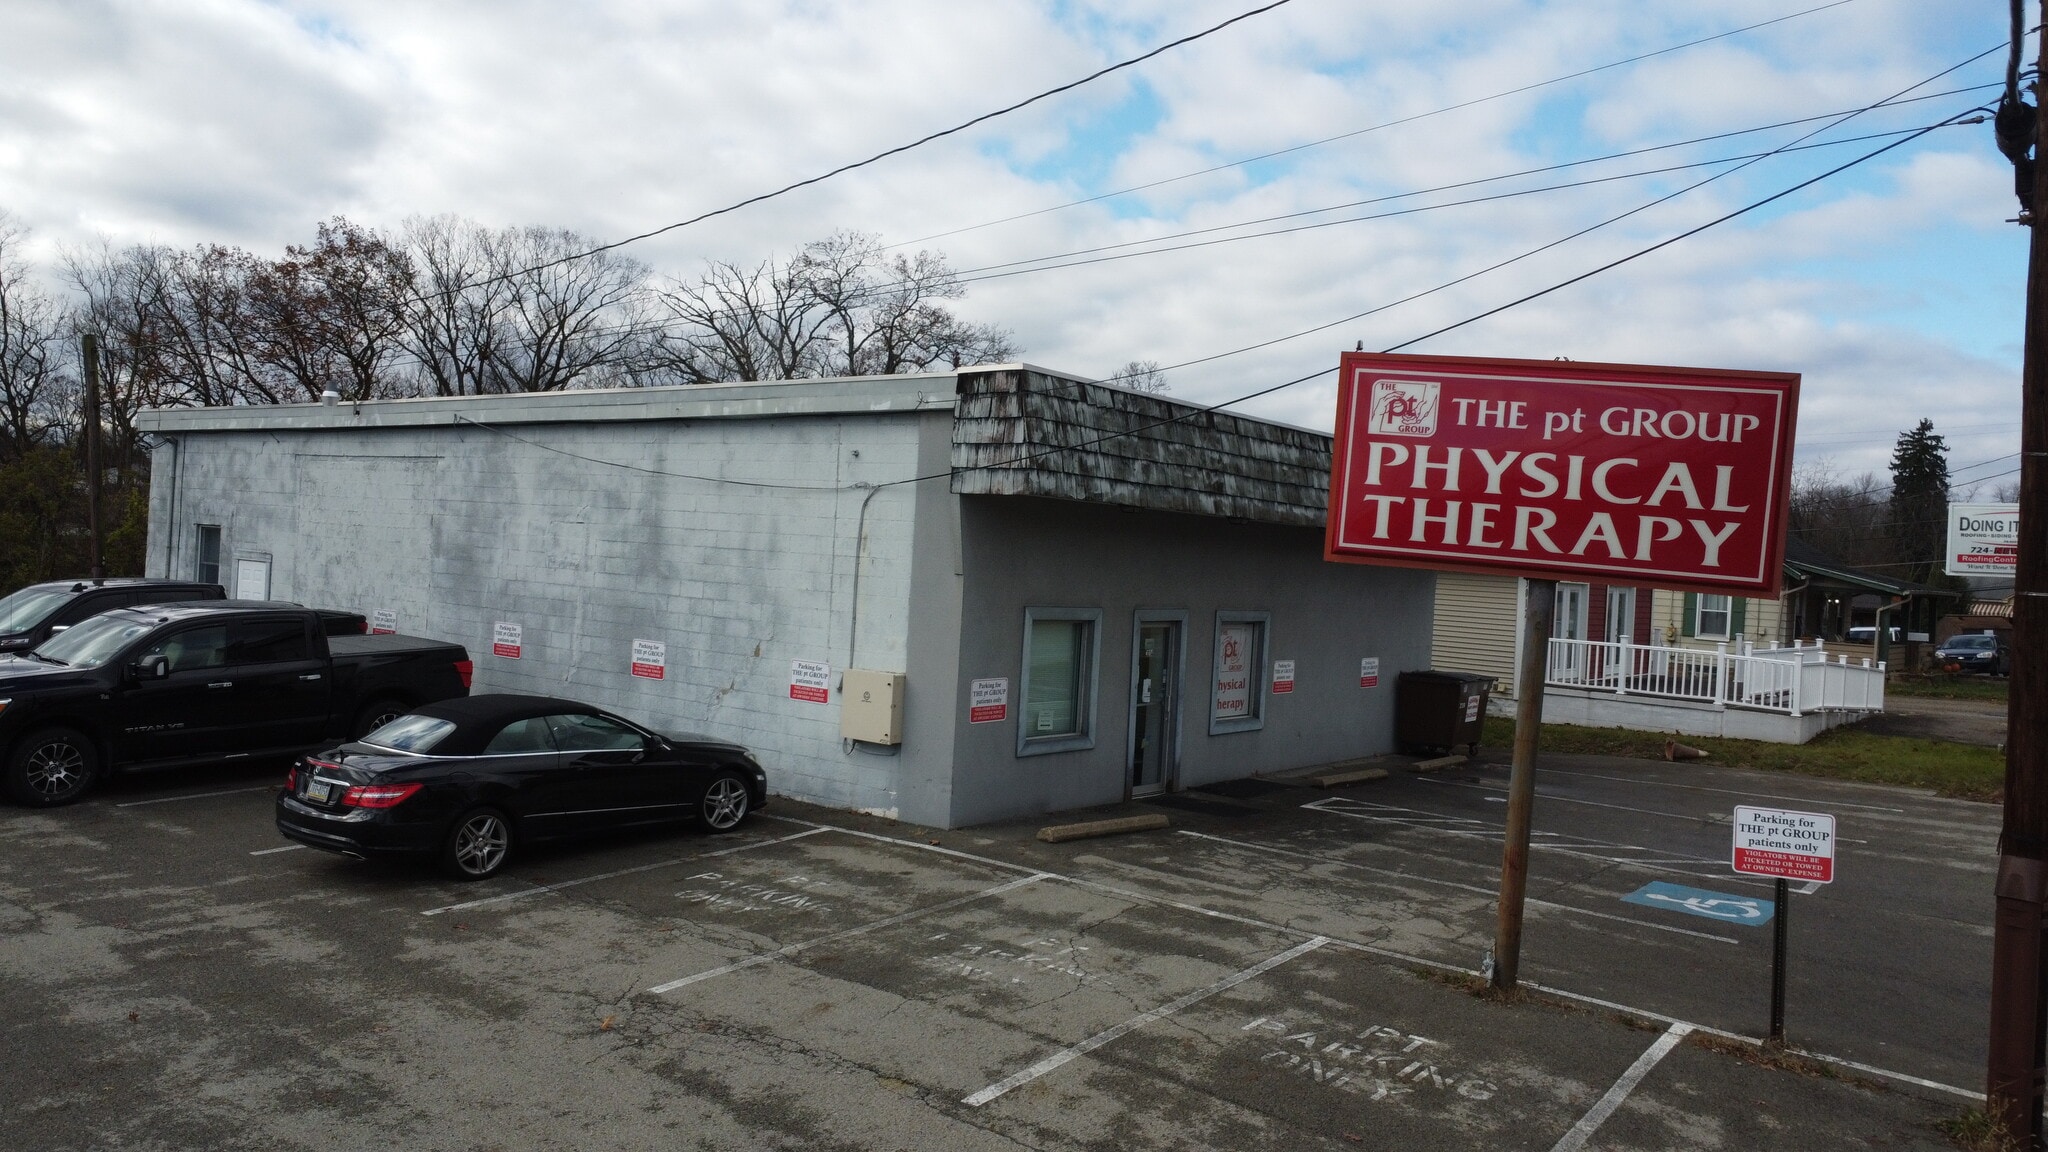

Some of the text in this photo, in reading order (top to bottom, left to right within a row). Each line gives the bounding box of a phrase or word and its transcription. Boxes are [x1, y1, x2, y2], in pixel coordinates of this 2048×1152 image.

[1388, 395, 1417, 424] pt
[1452, 398, 1760, 443] THE pt GROUP
[1398, 425, 1430, 433] GROUP
[1364, 442, 1750, 513] PHYSICAL
[1363, 494, 1742, 567] THERAPY
[798, 663, 815, 671] Parking
[1753, 813, 1815, 828] Parking for
[1739, 823, 1830, 840] THE pt GROUP
[1749, 838, 1818, 854] patients only
[1745, 850, 1787, 860] VIOLATORS
[1744, 856, 1780, 866] TICKETED
[1796, 863, 1823, 871] TOWED
[1753, 864, 1786, 873] OWNERS'
